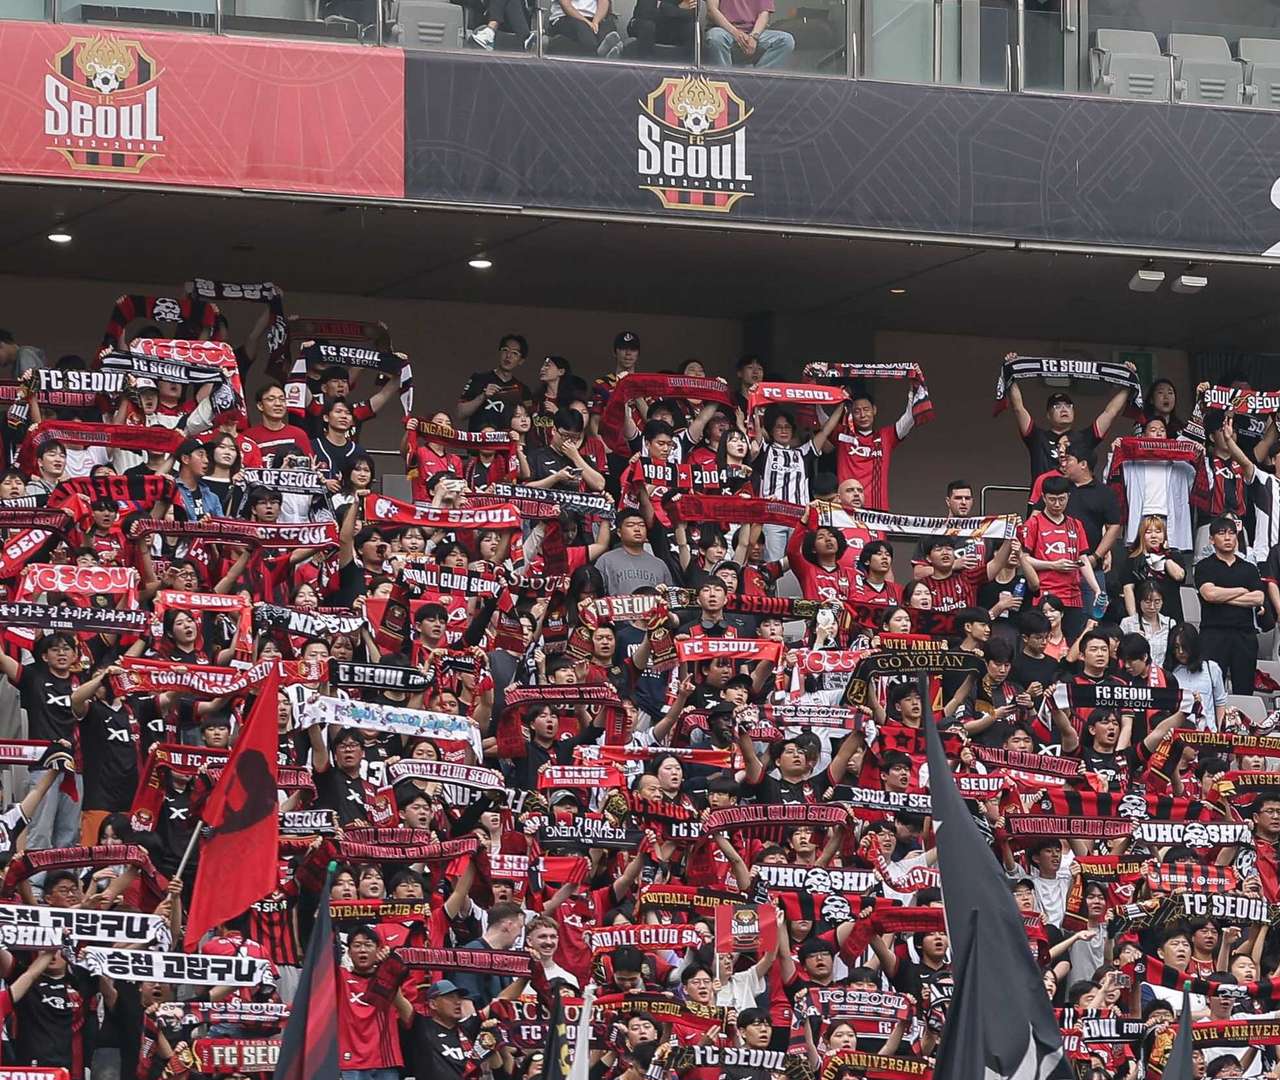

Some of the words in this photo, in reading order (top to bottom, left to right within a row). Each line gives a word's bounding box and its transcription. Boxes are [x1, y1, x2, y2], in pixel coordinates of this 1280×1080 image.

[44, 72, 164, 141] Seoul
[637, 111, 753, 182] Seoul
[320, 345, 338, 356] FC
[340, 347, 382, 362] SEOUL
[1042, 358, 1057, 372] FC
[1059, 360, 1099, 375] SEOUL
[762, 386, 781, 399] FC
[783, 388, 834, 402] SEOUL
[643, 464, 672, 482] 1983
[694, 469, 727, 485] 2004
[413, 504, 444, 521] FC
[447, 504, 517, 523] SEOUL
[683, 641, 705, 654] FC
[709, 639, 759, 653] SEOUL
[876, 657, 894, 671] GO
[898, 653, 964, 671] YOHAN
[1096, 685, 1111, 700] FC
[1113, 686, 1153, 701] SEOUL
[1180, 732, 1230, 748] FOOTBALL
[1232, 734, 1258, 748] CLUB
[284, 811, 332, 829] SEOUL
[1184, 893, 1208, 915] FC
[1212, 892, 1272, 924] SEOUL
[731, 919, 760, 935] Seoul
[107, 951, 153, 975] 승점
[163, 952, 257, 982] 고맙구나
[212, 1047, 239, 1068] FC
[694, 1046, 719, 1066] FC
[725, 1047, 786, 1070] SEOUL
[844, 1052, 930, 1075] ANNIVERSARY
